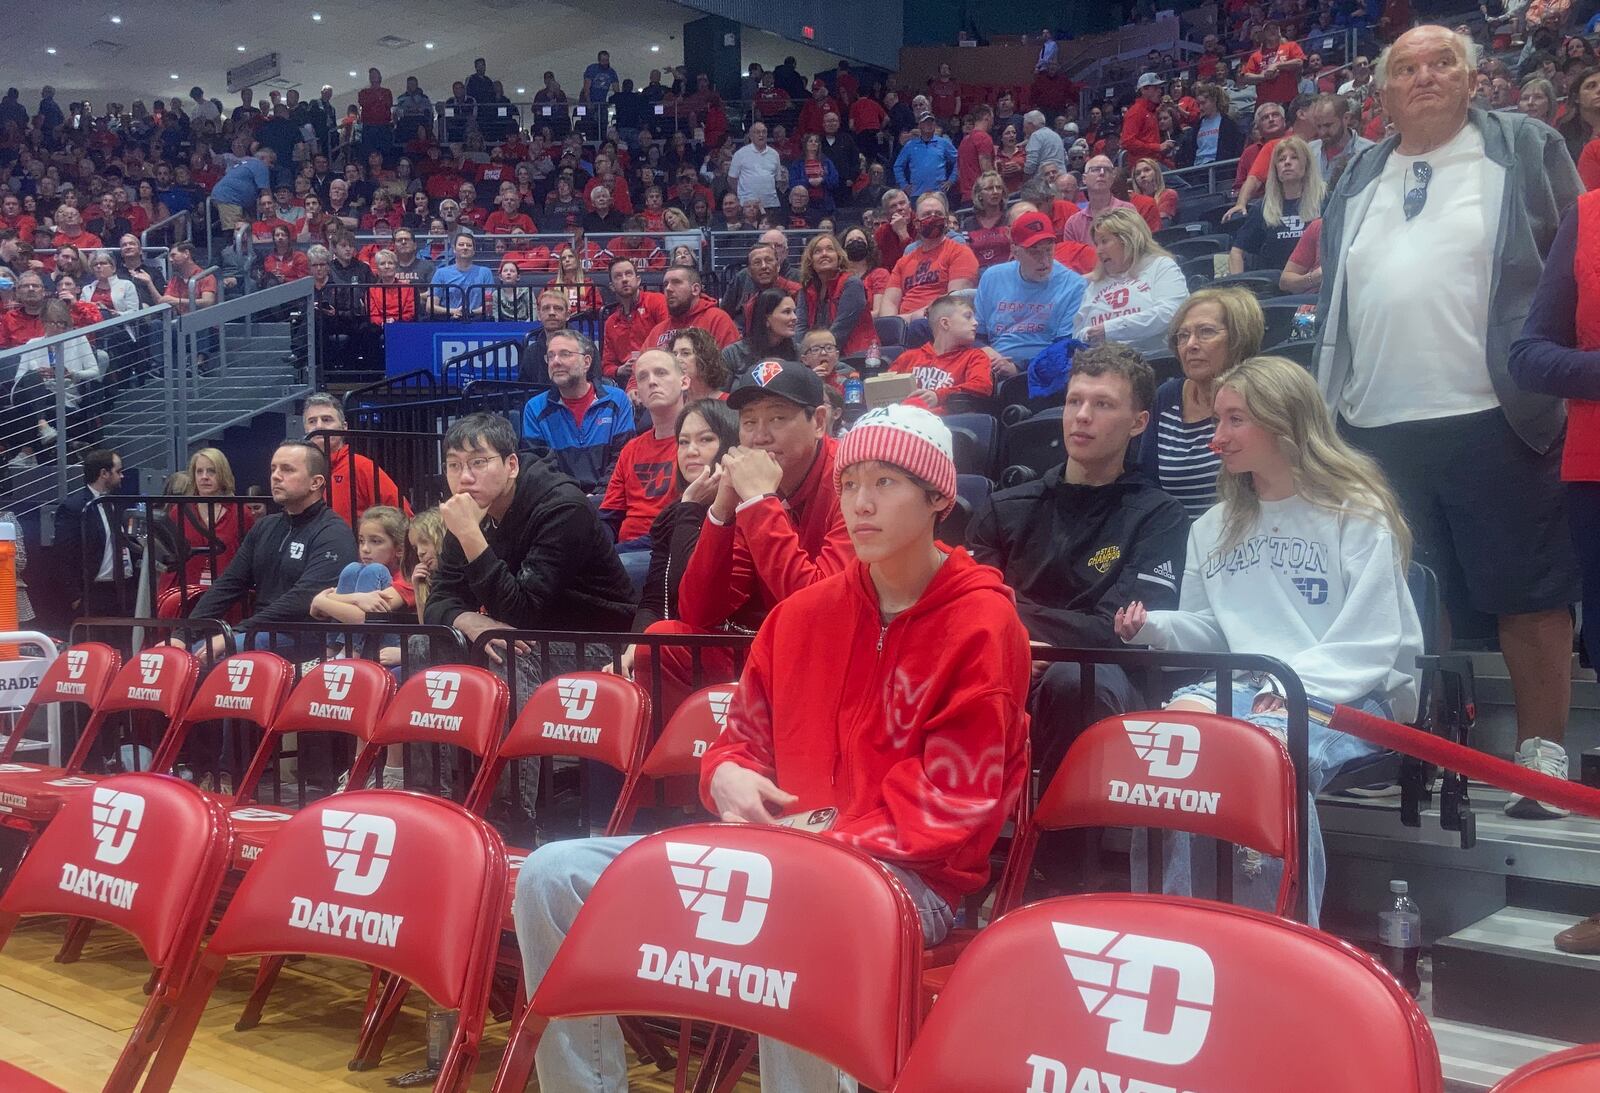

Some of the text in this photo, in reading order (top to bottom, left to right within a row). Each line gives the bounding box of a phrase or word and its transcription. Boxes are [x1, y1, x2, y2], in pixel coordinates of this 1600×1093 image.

[1206, 535, 1328, 579] DAYTON
[1153, 567, 1176, 580] adidas
[56, 681, 87, 695] DAYTON
[127, 687, 163, 702] DAYTON
[215, 695, 254, 710] DAYTON
[309, 701, 355, 721] DAYTON
[409, 710, 463, 732] DAYTON
[541, 721, 601, 744] DAYTON
[1108, 779, 1221, 815] DAYTON
[59, 862, 139, 910] DAYTON
[288, 896, 404, 948] DAYTON
[637, 943, 798, 1010] DAYTON
